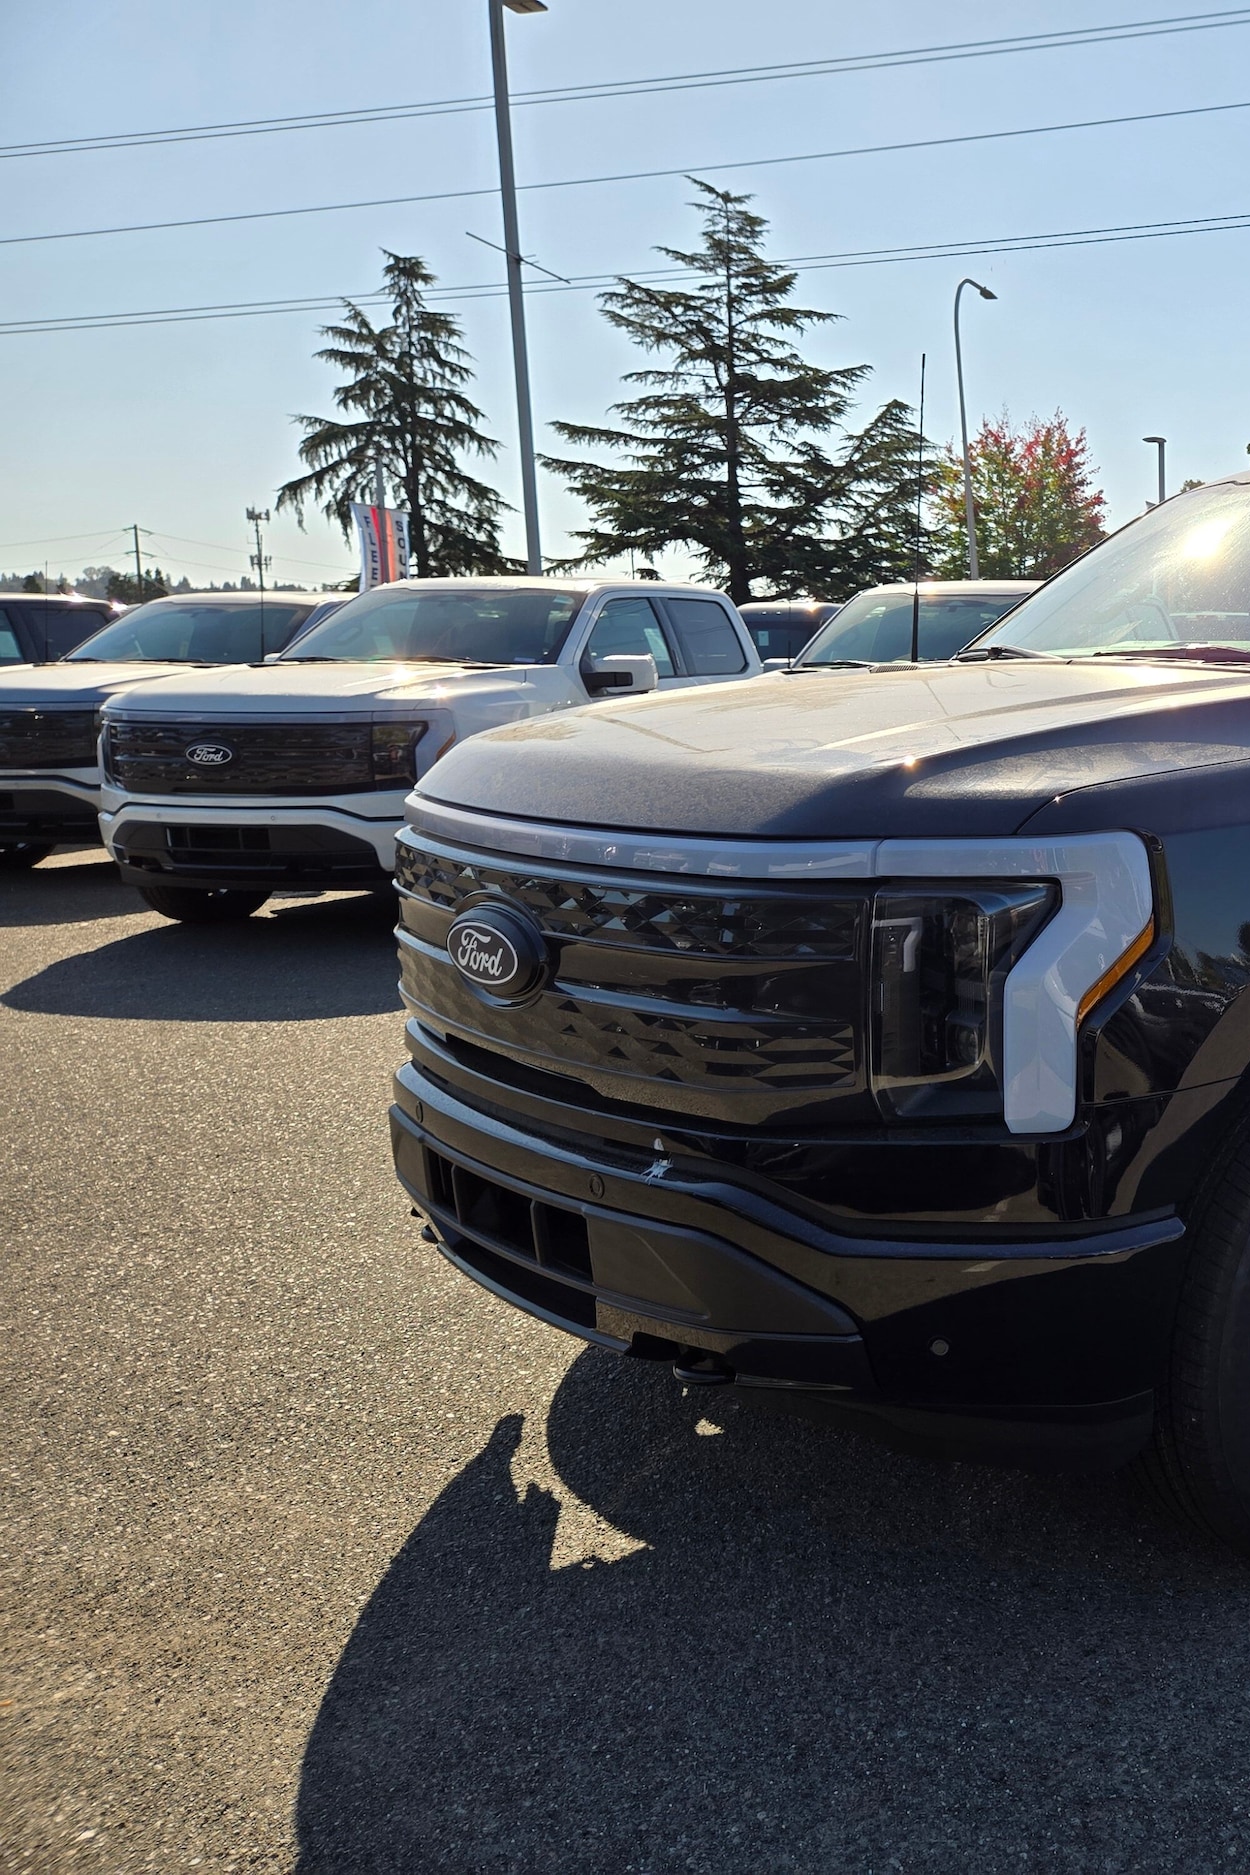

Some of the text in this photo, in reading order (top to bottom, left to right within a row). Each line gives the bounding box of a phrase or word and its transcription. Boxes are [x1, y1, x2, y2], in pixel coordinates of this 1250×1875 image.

[363, 516, 378, 587] FLEE
[194, 748, 224, 761] Ford
[458, 928, 503, 976] Ford
